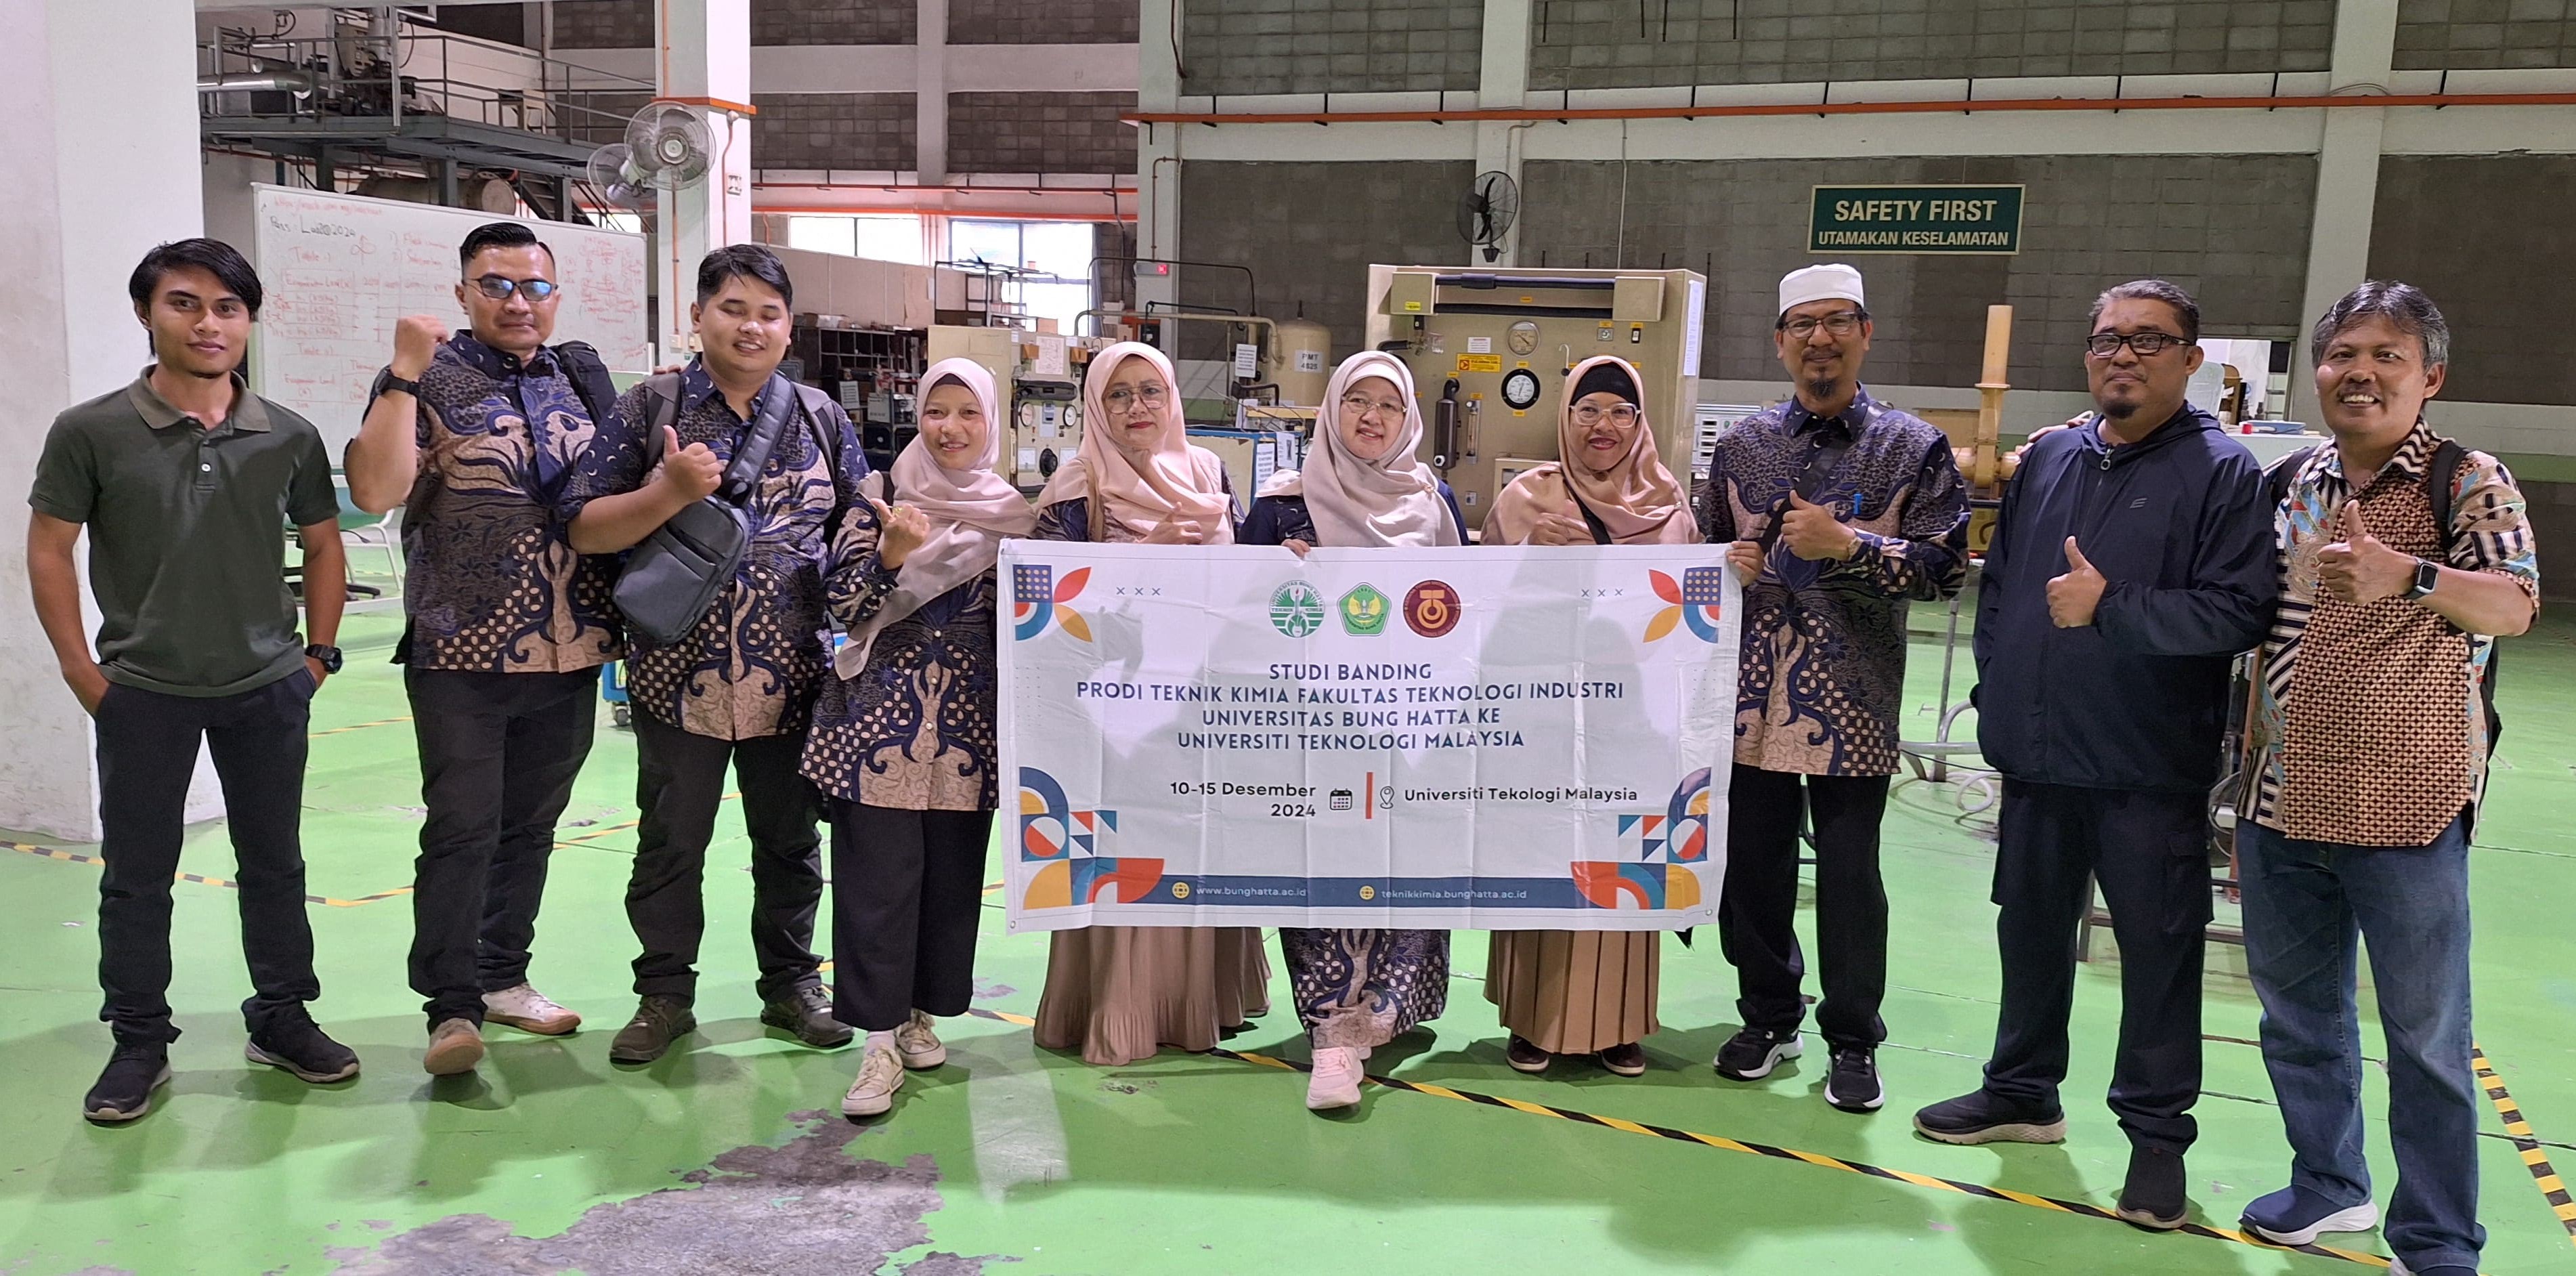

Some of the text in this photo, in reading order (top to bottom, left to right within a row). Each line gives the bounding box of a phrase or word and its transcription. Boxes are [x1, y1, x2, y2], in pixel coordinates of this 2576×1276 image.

[1835, 200, 1997, 221] SAFETY FIRST
[1819, 232, 2008, 245] UTAMAKAN KESELAMATAN
[1270, 664, 1431, 680] STUDI BANDING
[1077, 682, 1622, 704] PRODI TEKNIK KIMIA FAKULTAS TEKNOLOGI INDUSTRI
[1203, 708, 1499, 727] UNIVERSITAS BUNG HATTA KE
[1178, 731, 1524, 750] UNIVERSITI TEKNOLOGI MALAYSIA
[1171, 782, 1316, 796] 10-15 Desember
[1405, 787, 1637, 803] Universiti Tekologi Malaysia
[1271, 804, 1315, 816] 2024
[1197, 885, 1306, 897] www.bunghatta.ac.id
[1381, 887, 1526, 900] teknikkimia.bunghatta.ac.id
